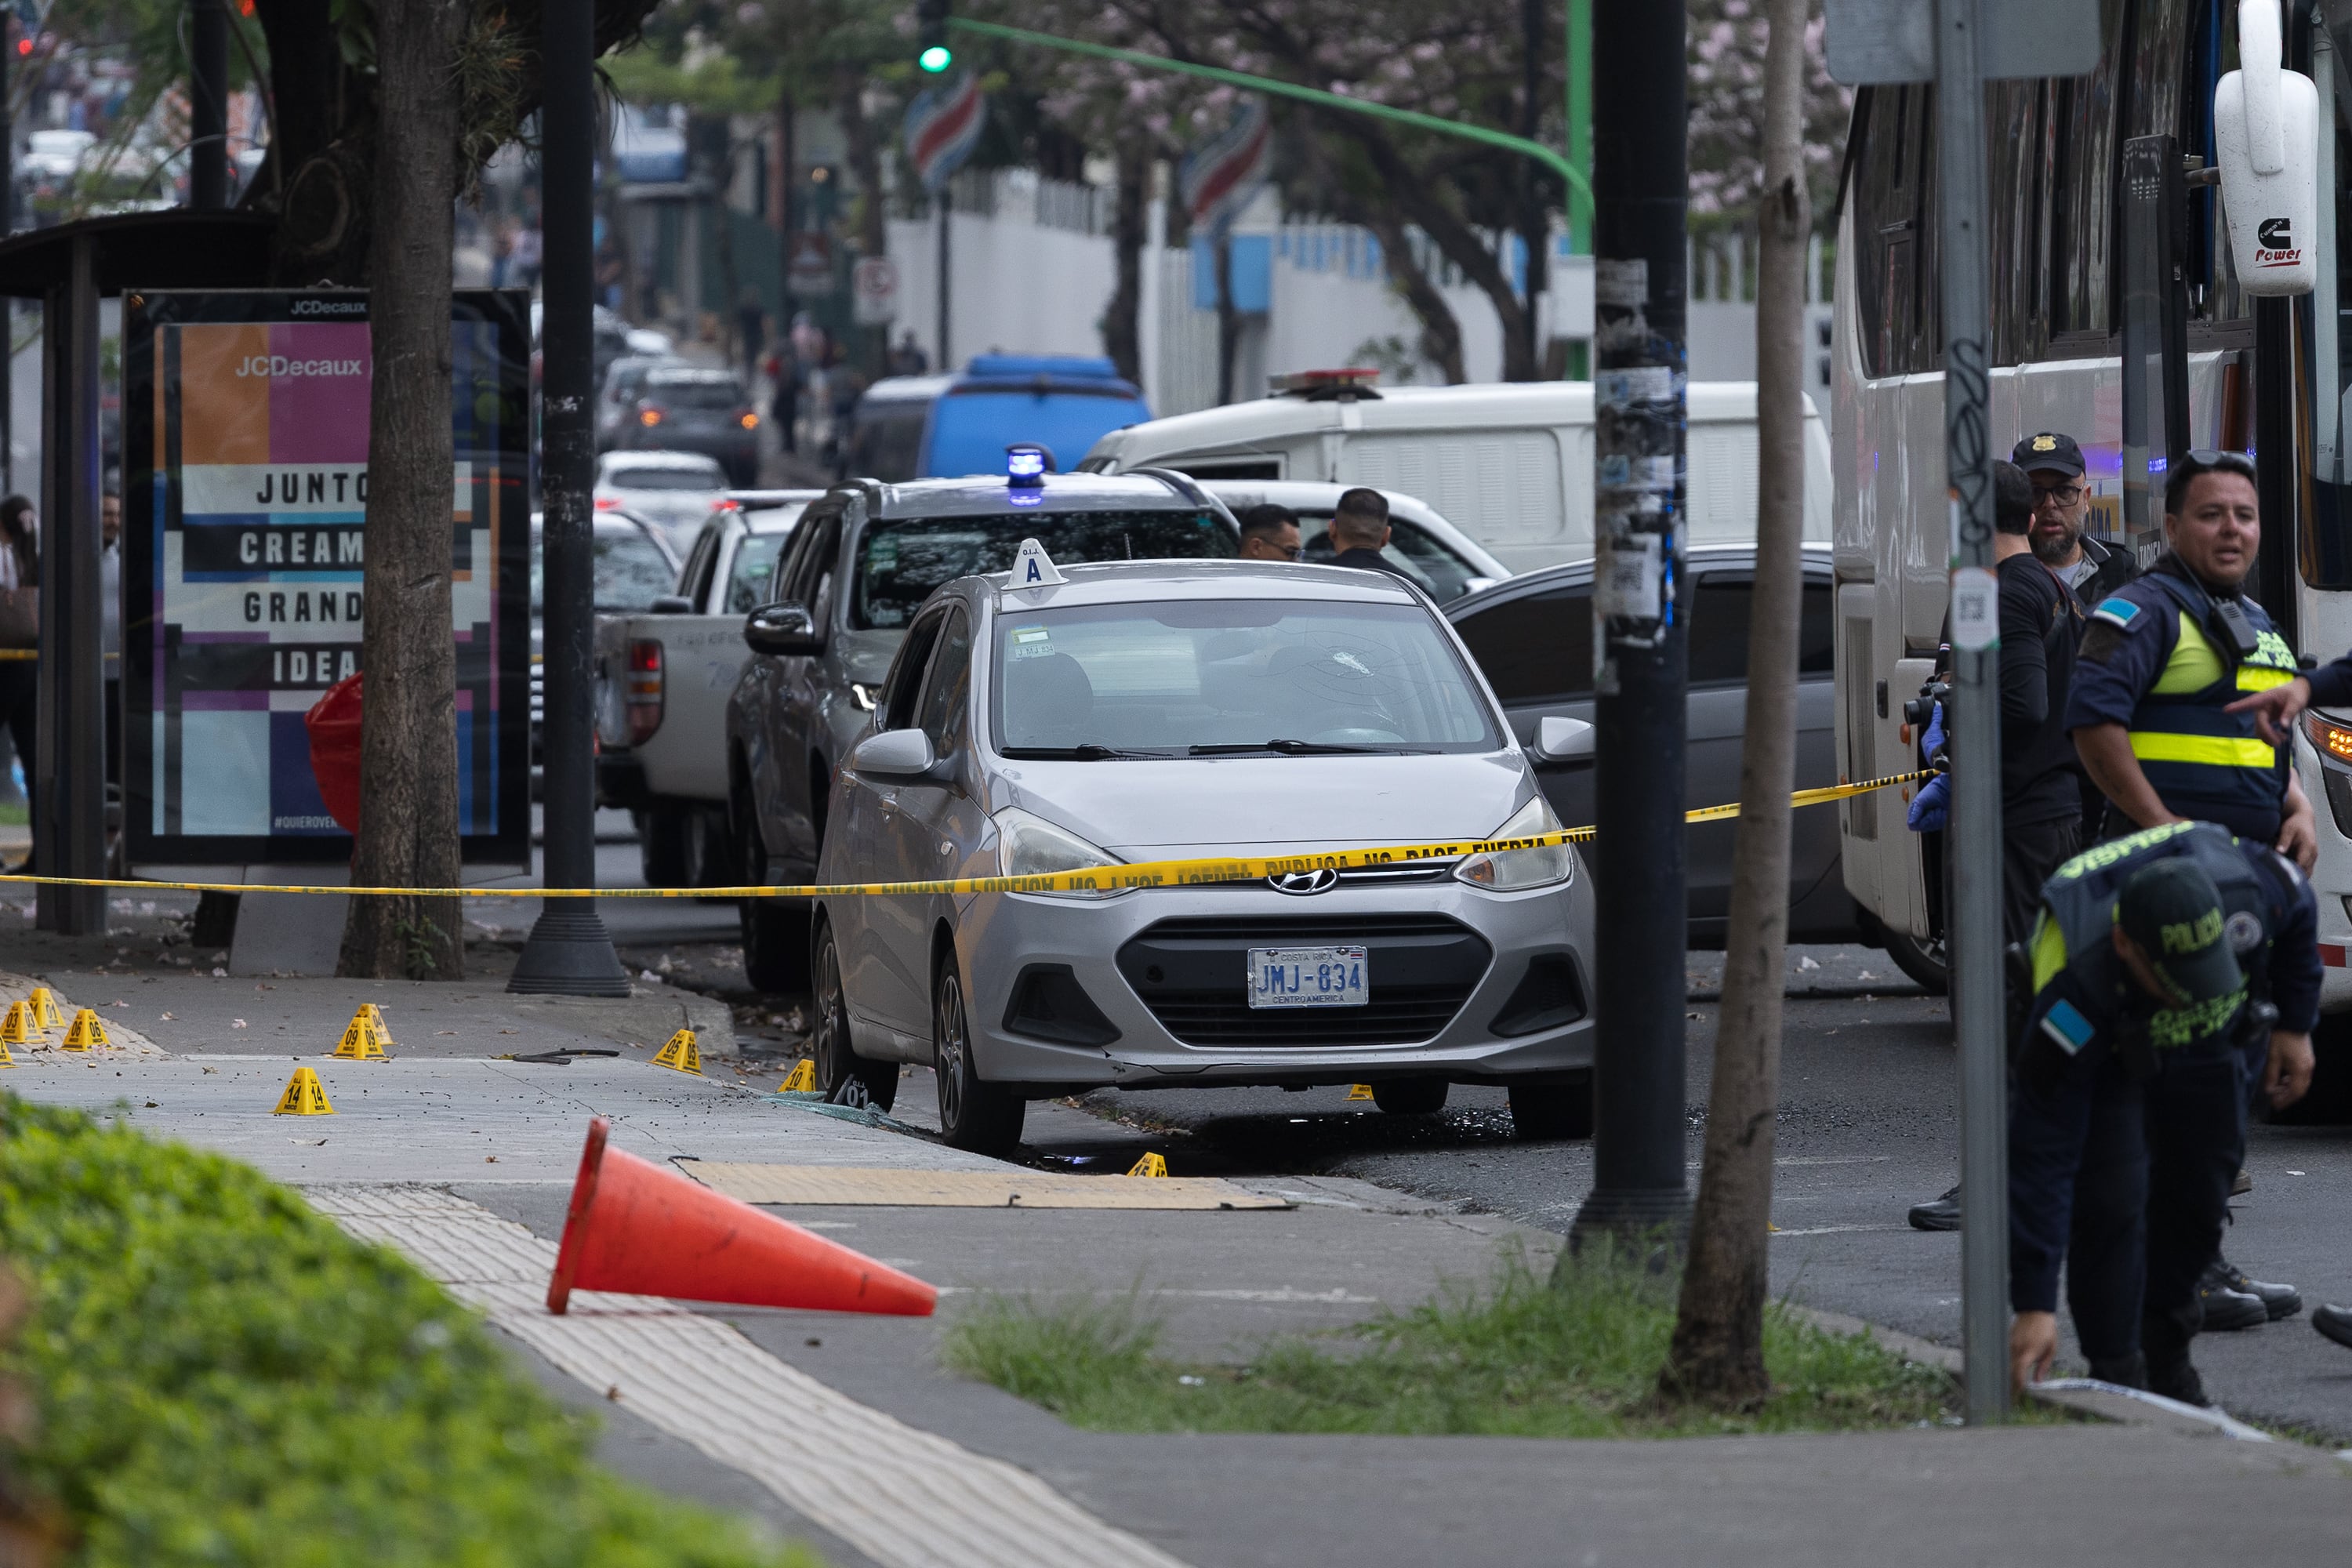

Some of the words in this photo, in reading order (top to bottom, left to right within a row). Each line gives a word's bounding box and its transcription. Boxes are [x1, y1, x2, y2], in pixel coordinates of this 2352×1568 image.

[2255, 249, 2302, 262] Power
[290, 300, 367, 314] JCDecaux
[235, 355, 362, 377] JCDecaux
[256, 473, 368, 503] JUNTO
[240, 531, 365, 564] CREAM
[1026, 558, 1042, 583] A
[244, 591, 364, 622] GRAND
[274, 650, 356, 682] IDEA
[1281, 953, 1310, 962] COSTA
[1313, 952, 1334, 961] RICA
[1256, 962, 1362, 994] JMJ-834
[1272, 994, 1345, 1004] CENTROAMERICA
[45, 1004, 58, 1019] 01
[6, 1012, 19, 1029] 03
[24, 1012, 36, 1029] 03
[71, 1021, 82, 1037] 06
[89, 1022, 101, 1038] 06
[345, 1029, 358, 1046] 09
[365, 1029, 376, 1046] 09
[666, 1039, 683, 1054] 05
[688, 1043, 696, 1061] 05
[789, 1070, 804, 1087] 10
[809, 1073, 815, 1091] 1
[289, 1085, 302, 1105] 14
[311, 1085, 323, 1105] 14
[847, 1085, 869, 1110] 01
